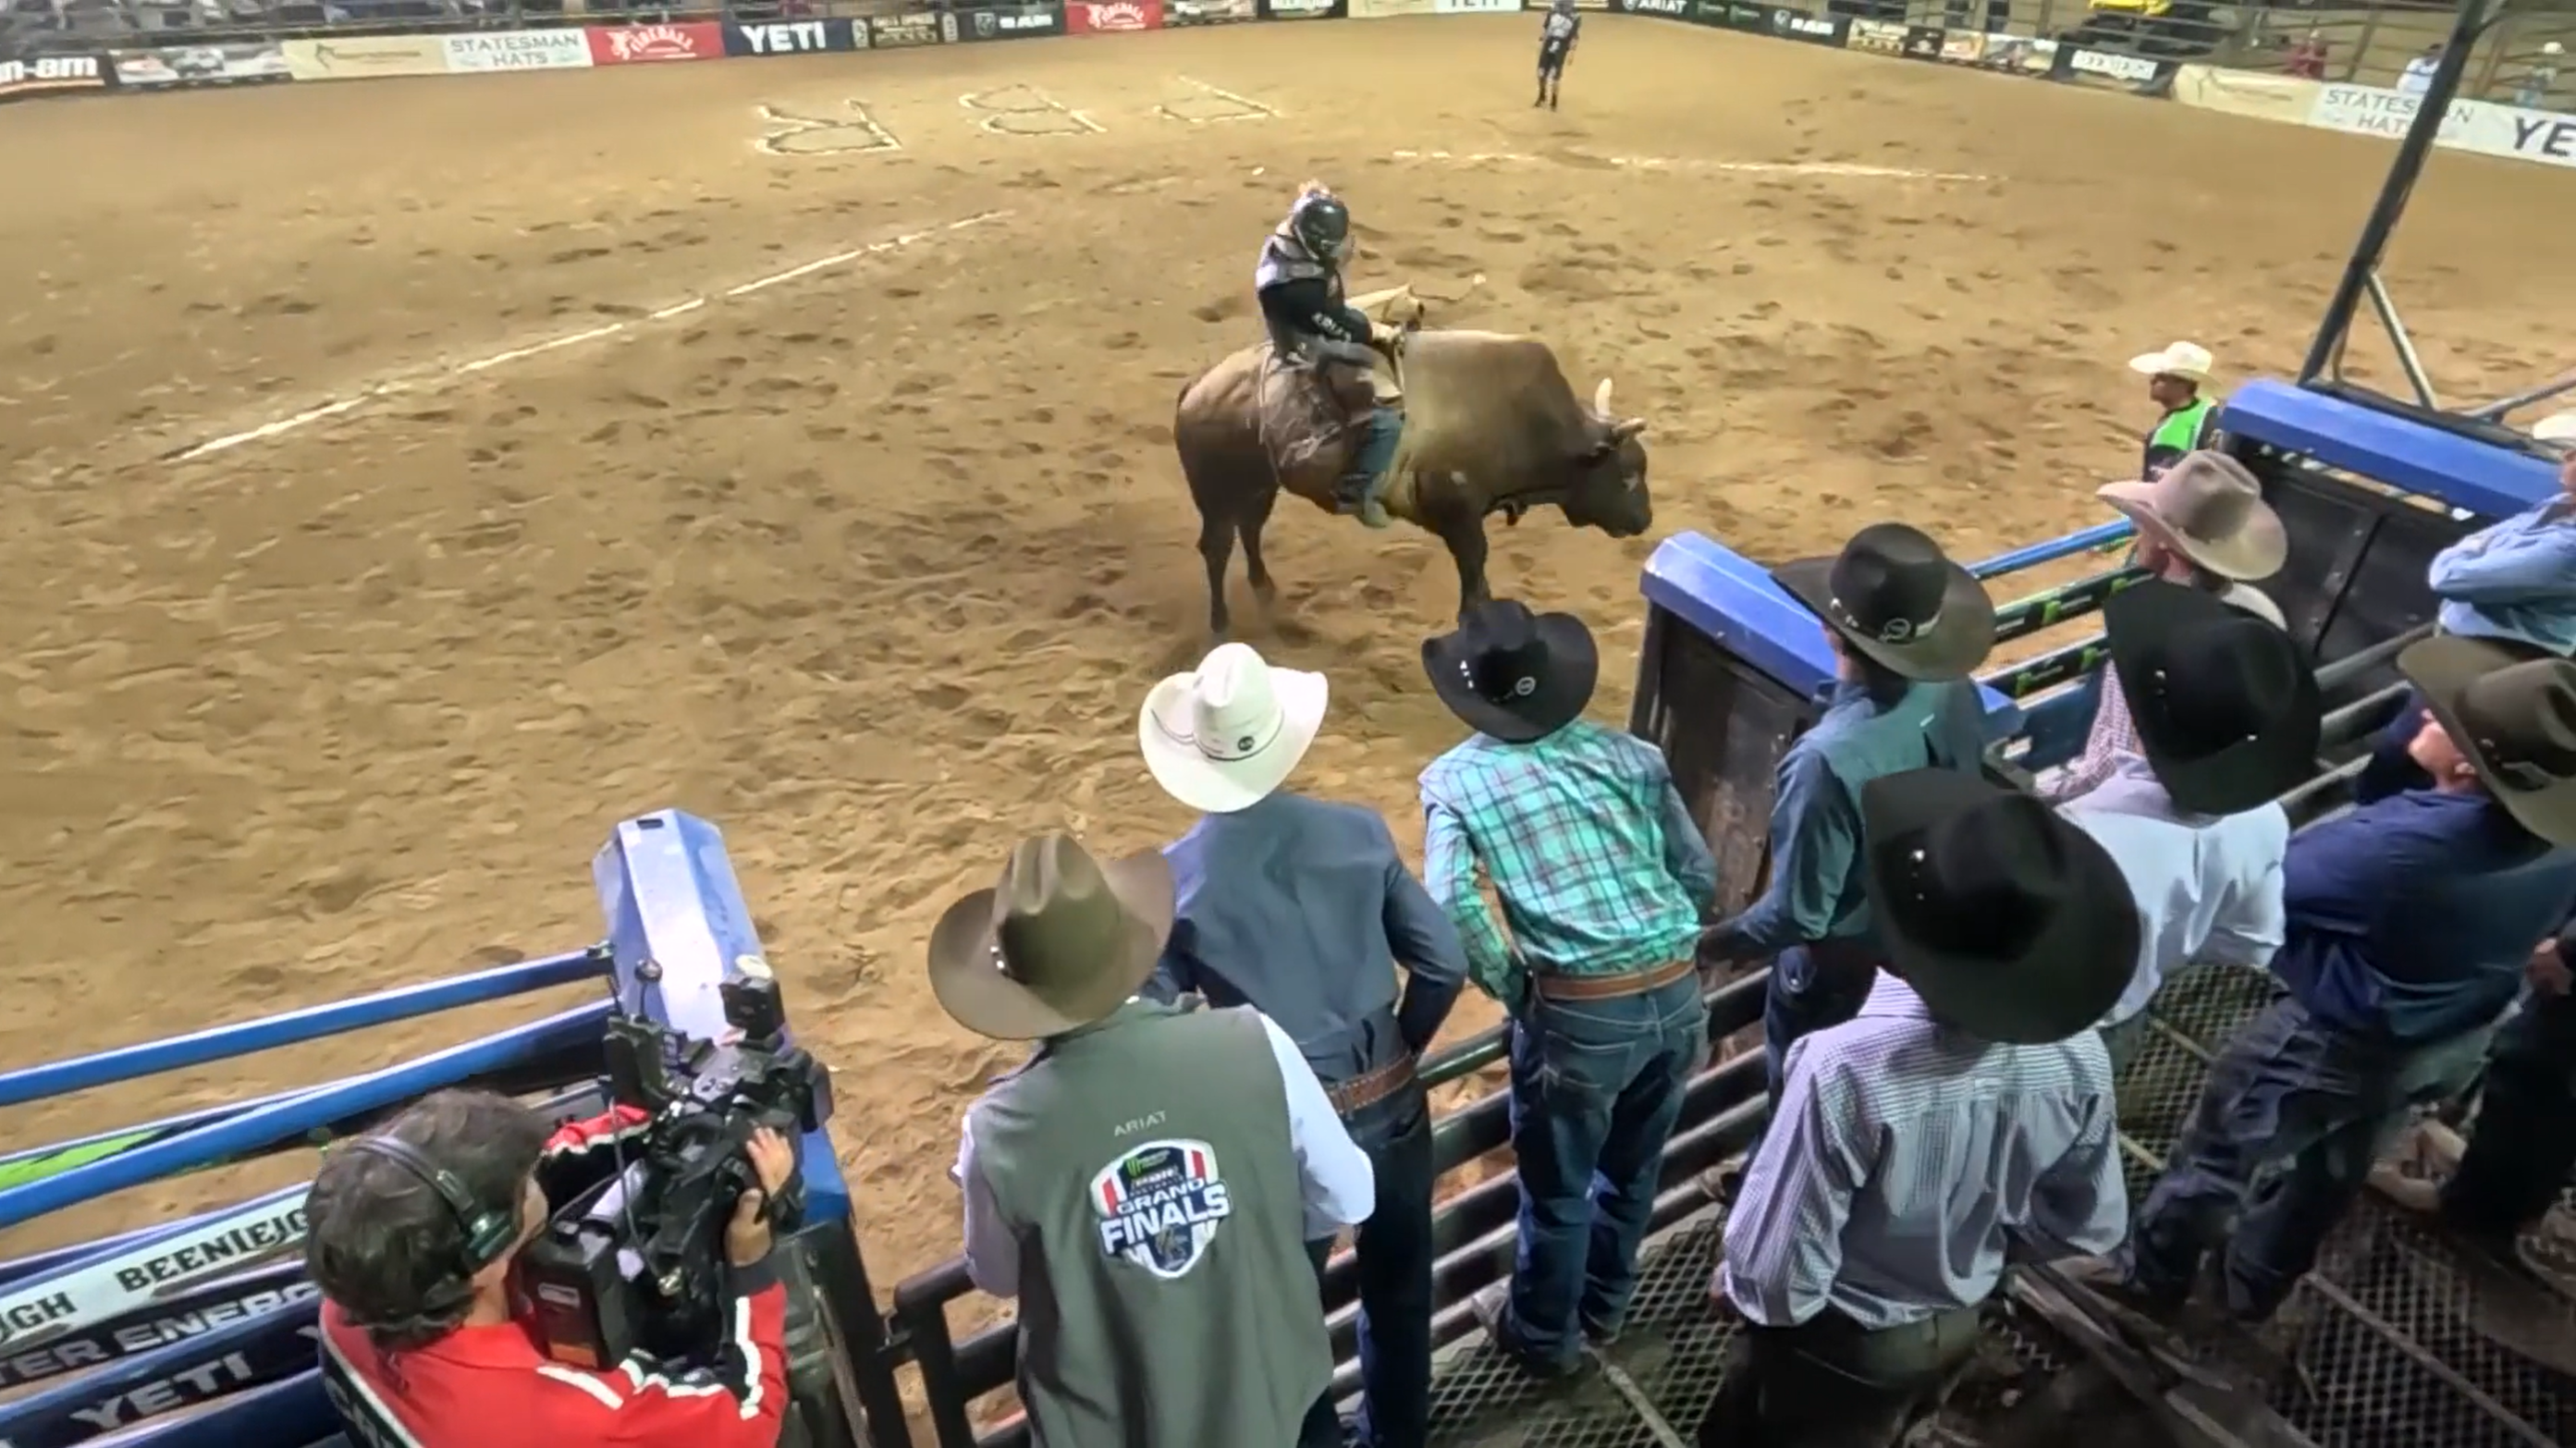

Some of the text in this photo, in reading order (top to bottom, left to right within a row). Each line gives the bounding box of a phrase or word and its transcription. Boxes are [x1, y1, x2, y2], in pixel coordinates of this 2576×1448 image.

[741, 20, 827, 53] YETI
[1790, 18, 1834, 35] RAM
[450, 34, 580, 53] STATESMAN
[492, 52, 548, 67] HATS
[2325, 89, 2475, 124] STATESN
[1114, 1110, 1167, 1136] ARIAT
[1116, 1178, 1205, 1216] GRAND
[1100, 1183, 1232, 1255] FINALS
[70, 1352, 253, 1430] YETI
